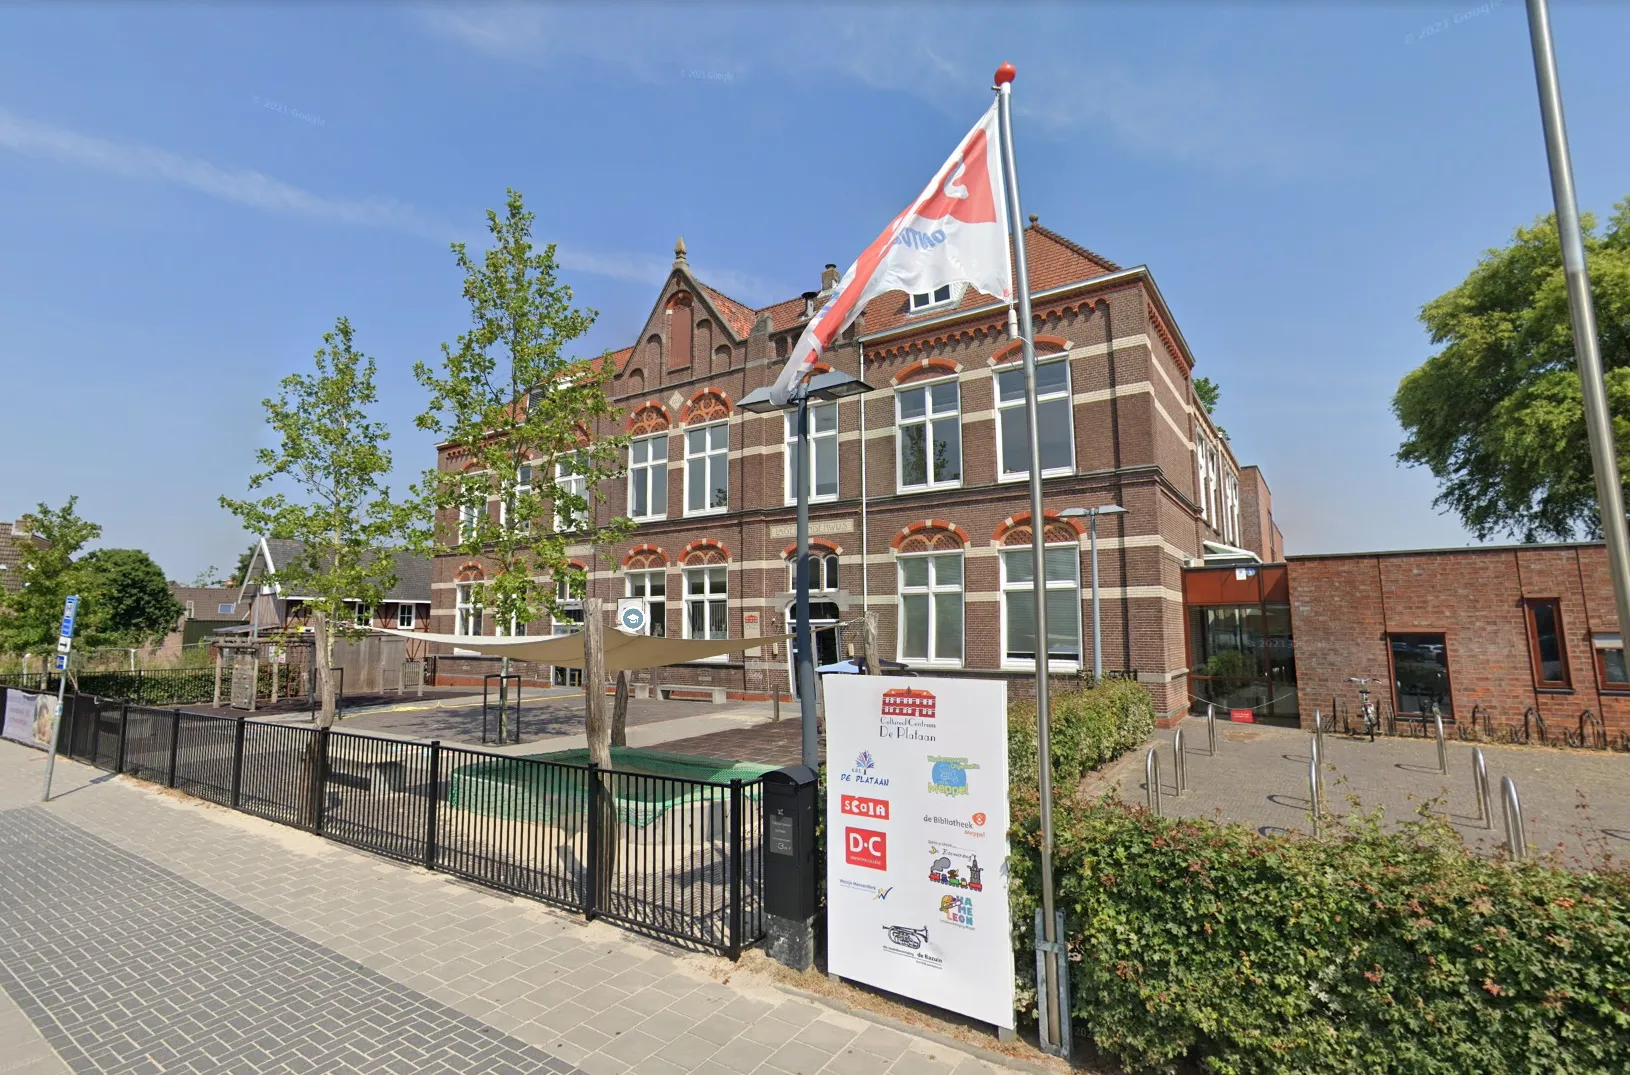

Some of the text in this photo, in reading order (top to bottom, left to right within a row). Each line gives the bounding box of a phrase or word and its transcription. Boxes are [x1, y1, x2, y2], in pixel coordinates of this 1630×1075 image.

[880, 715, 936, 728] Cultureel Centrum
[880, 725, 936, 742] De Plataan
[840, 773, 889, 787] DE PLATAAN
[927, 781, 969, 798] Meppel
[923, 814, 973, 830] de Bibliotheek
[964, 829, 986, 839] Meppel
[924, 953, 943, 964] Bazuin
